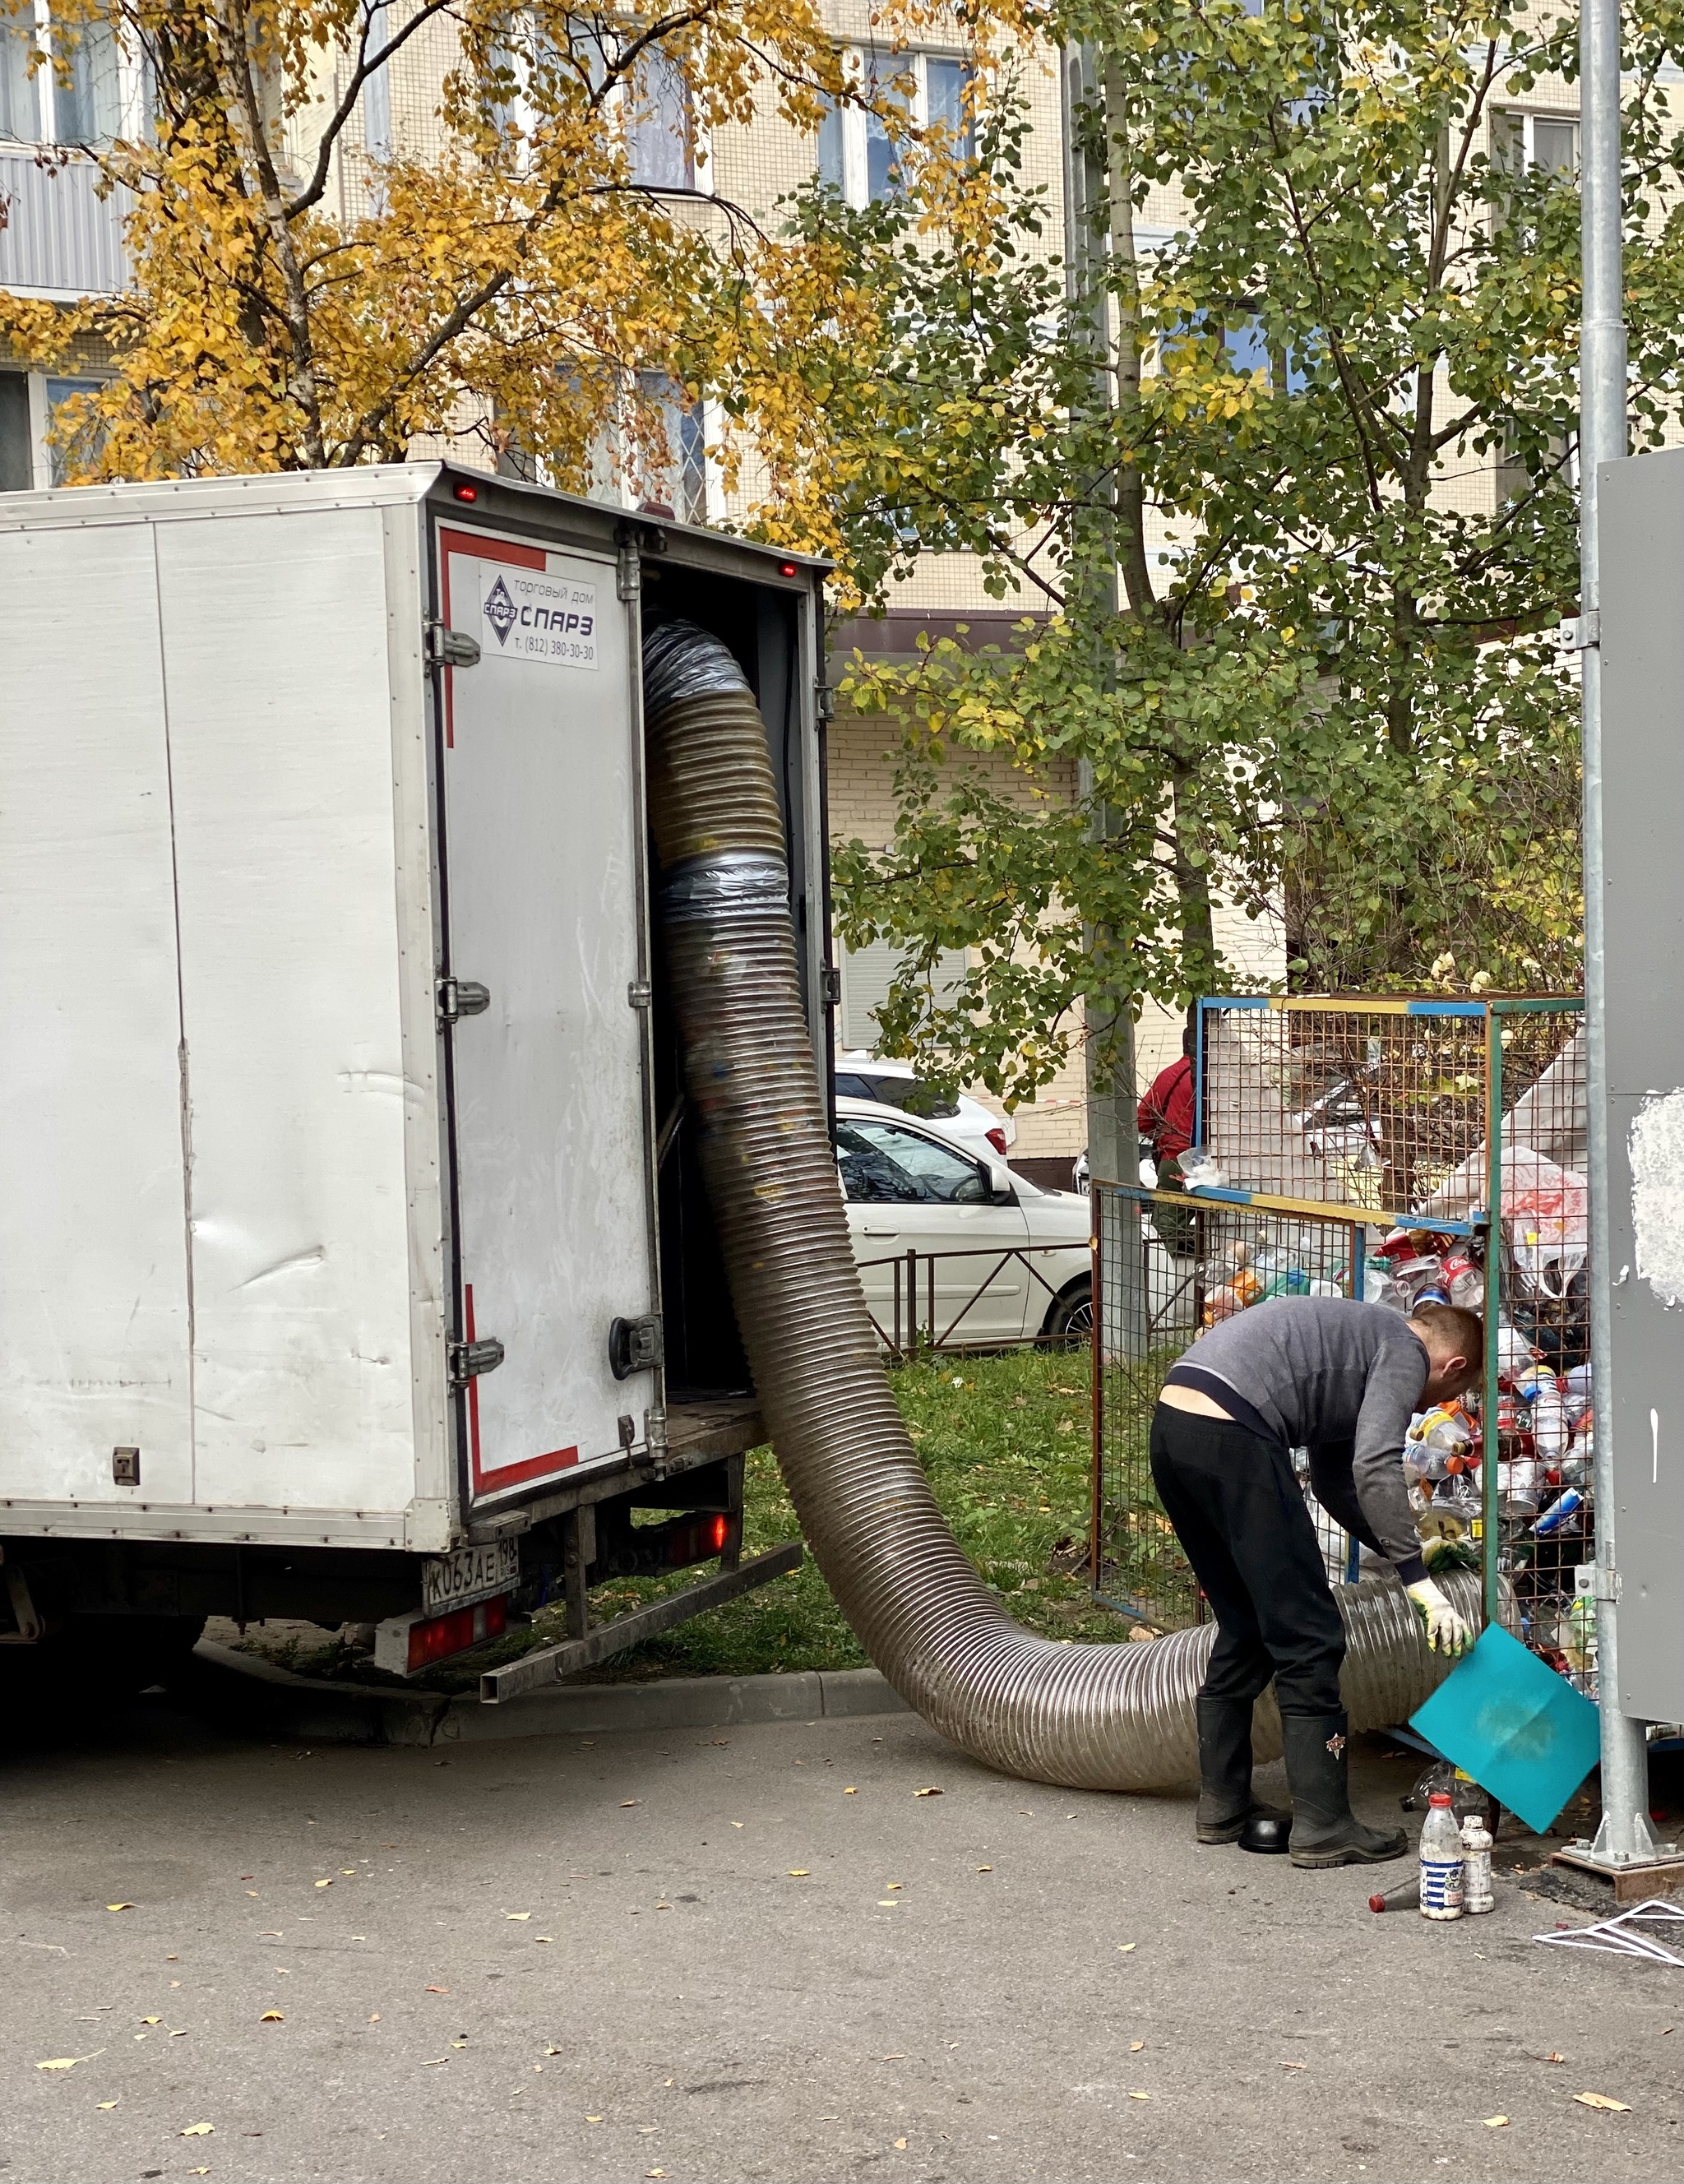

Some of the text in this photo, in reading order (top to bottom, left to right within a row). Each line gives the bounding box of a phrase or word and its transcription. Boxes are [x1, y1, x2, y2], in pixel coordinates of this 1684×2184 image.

[514, 580, 594, 605] торговый дом
[484, 604, 516, 618] СПАРЗ
[520, 605, 594, 636] СПАРЗ
[525, 636, 548, 656] (812)
[551, 640, 594, 660] 380-30-30
